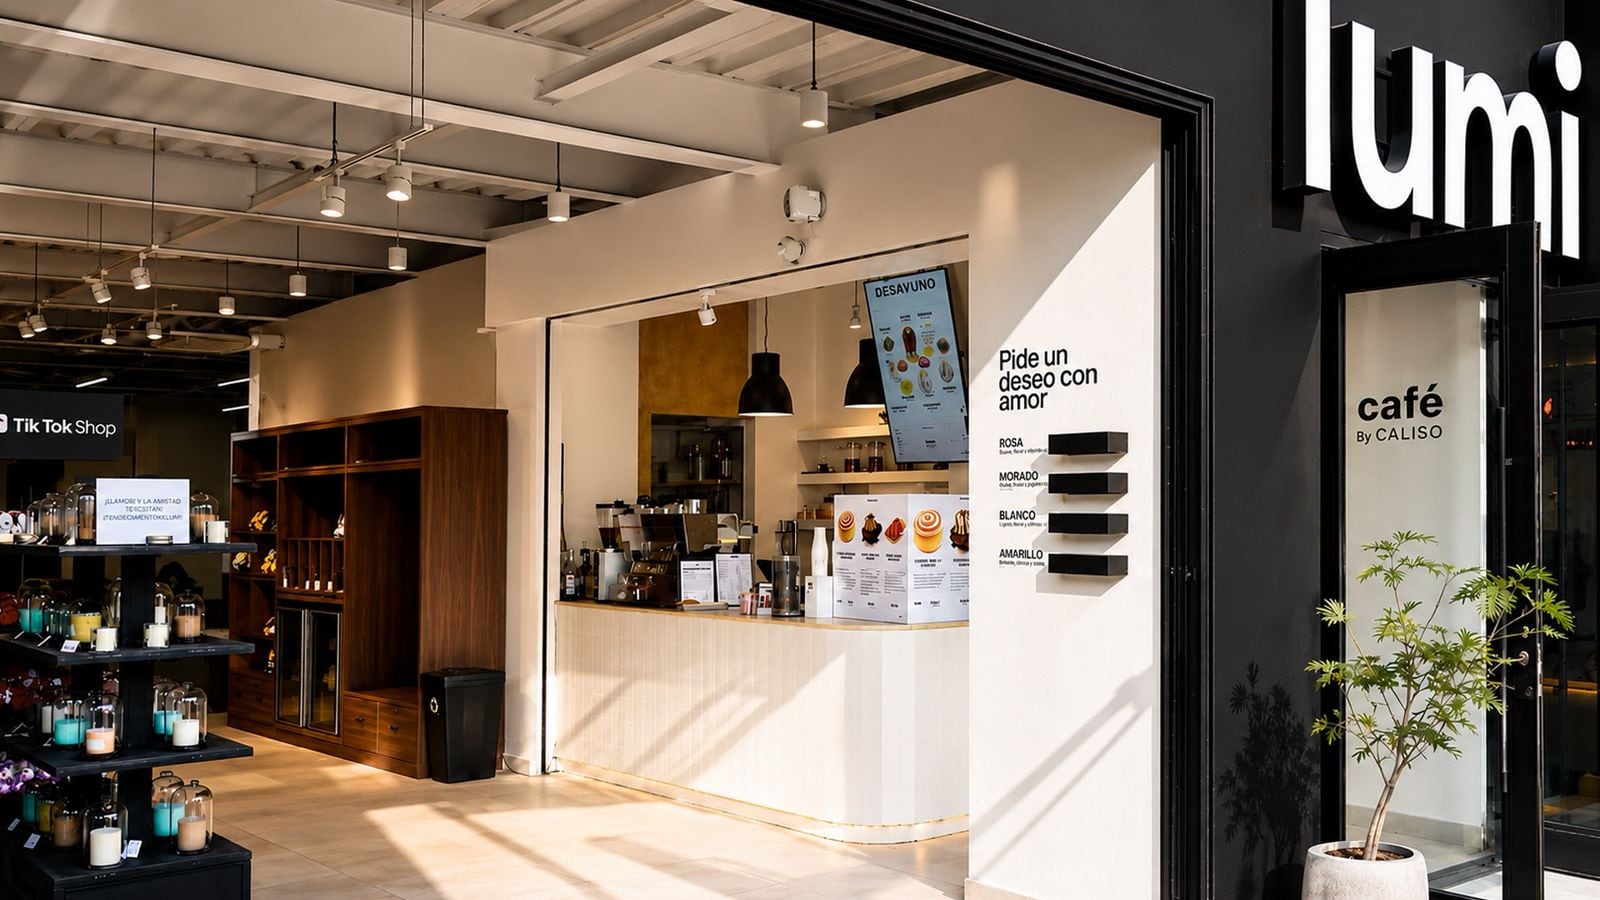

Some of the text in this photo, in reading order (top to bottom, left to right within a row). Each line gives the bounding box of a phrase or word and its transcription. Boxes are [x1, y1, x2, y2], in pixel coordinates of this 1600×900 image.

[1304, 0, 1582, 260] lumi
[1000, 348, 1068, 371] Pide un
[999, 368, 1097, 392] deseo con
[999, 392, 1048, 411] amor
[1358, 383, 1443, 421] café
[13, 417, 117, 438] Tik Tok Shop
[1357, 425, 1443, 445] By CALISO
[999, 437, 1024, 448] ROSA
[999, 470, 1039, 481] MORADO
[999, 510, 1036, 521] BLANCO
[999, 548, 1043, 560] AMARILLO
